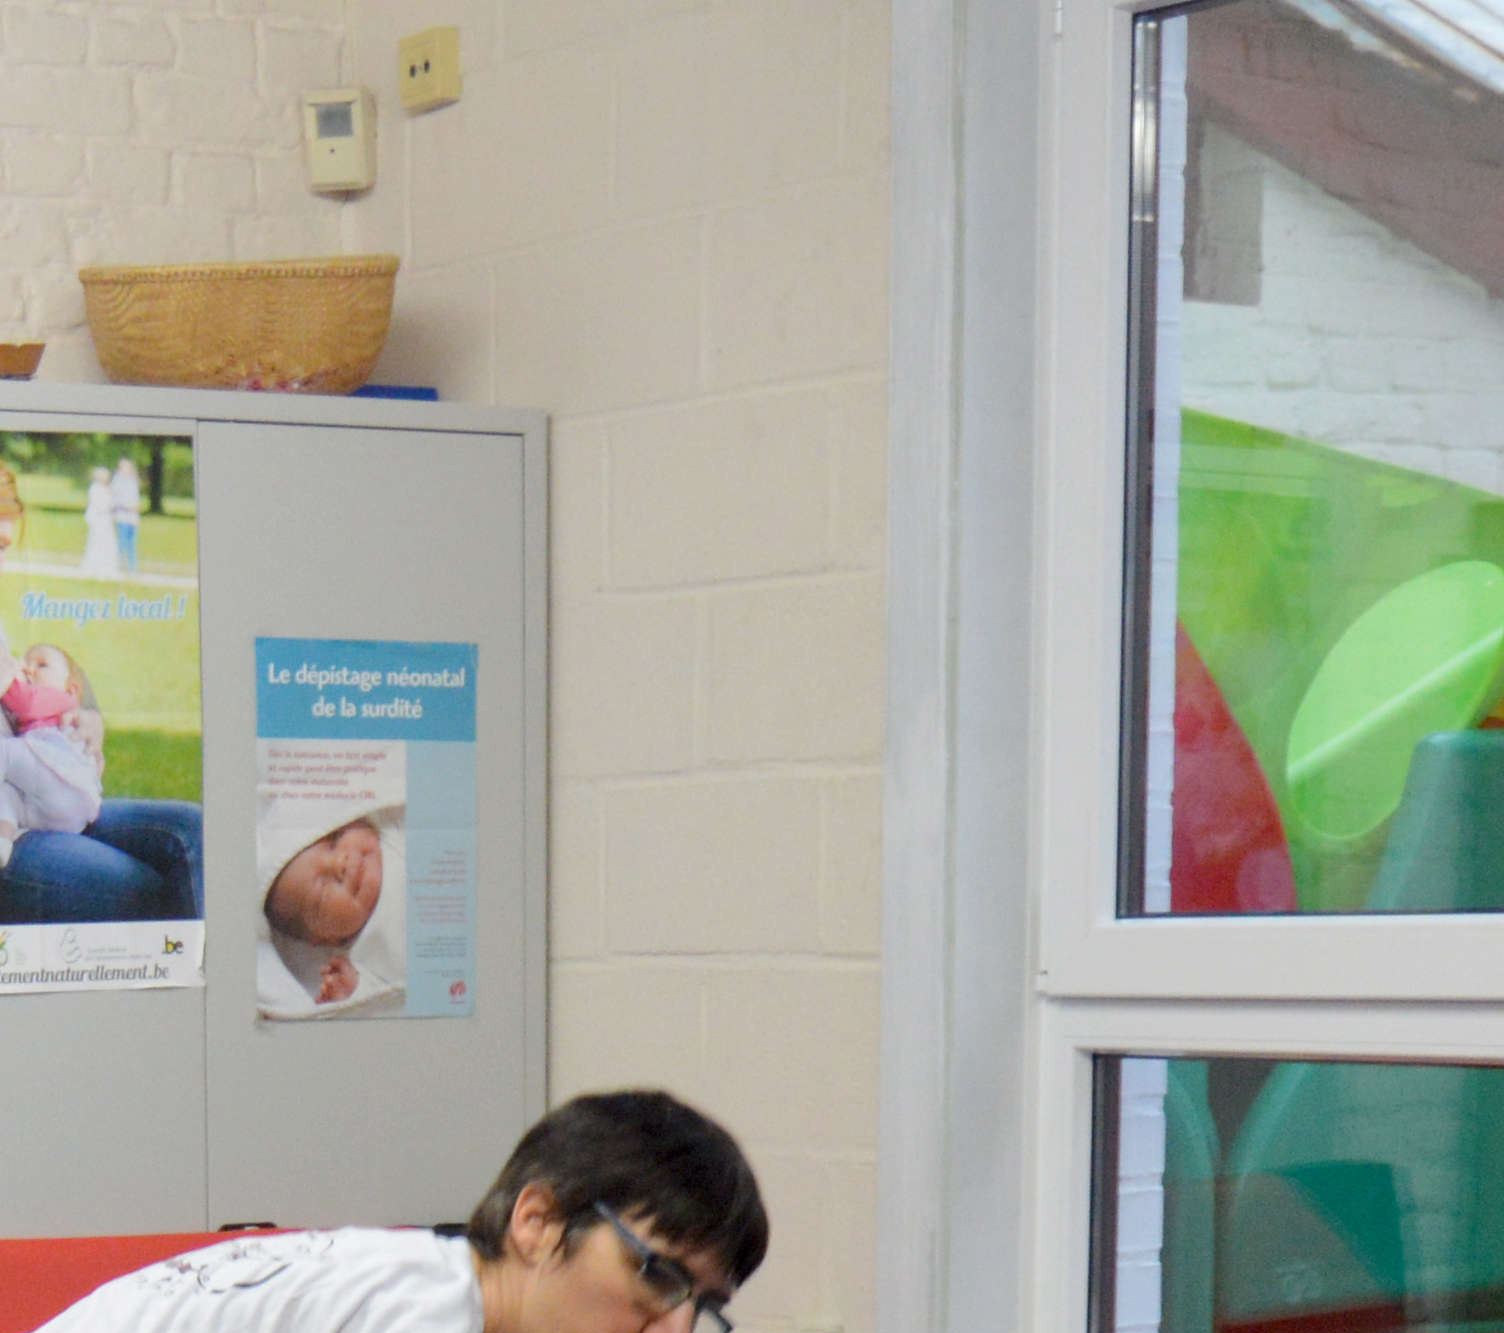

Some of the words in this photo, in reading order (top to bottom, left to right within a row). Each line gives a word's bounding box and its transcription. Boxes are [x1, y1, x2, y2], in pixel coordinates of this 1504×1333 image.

[21, 591, 112, 628] Mangez
[117, 593, 172, 620] local
[268, 663, 290, 684] Le
[295, 663, 382, 693] dépistage
[387, 667, 465, 688] néonatal
[312, 695, 335, 717] de
[341, 696, 356, 717] la
[361, 698, 424, 719] surdité
